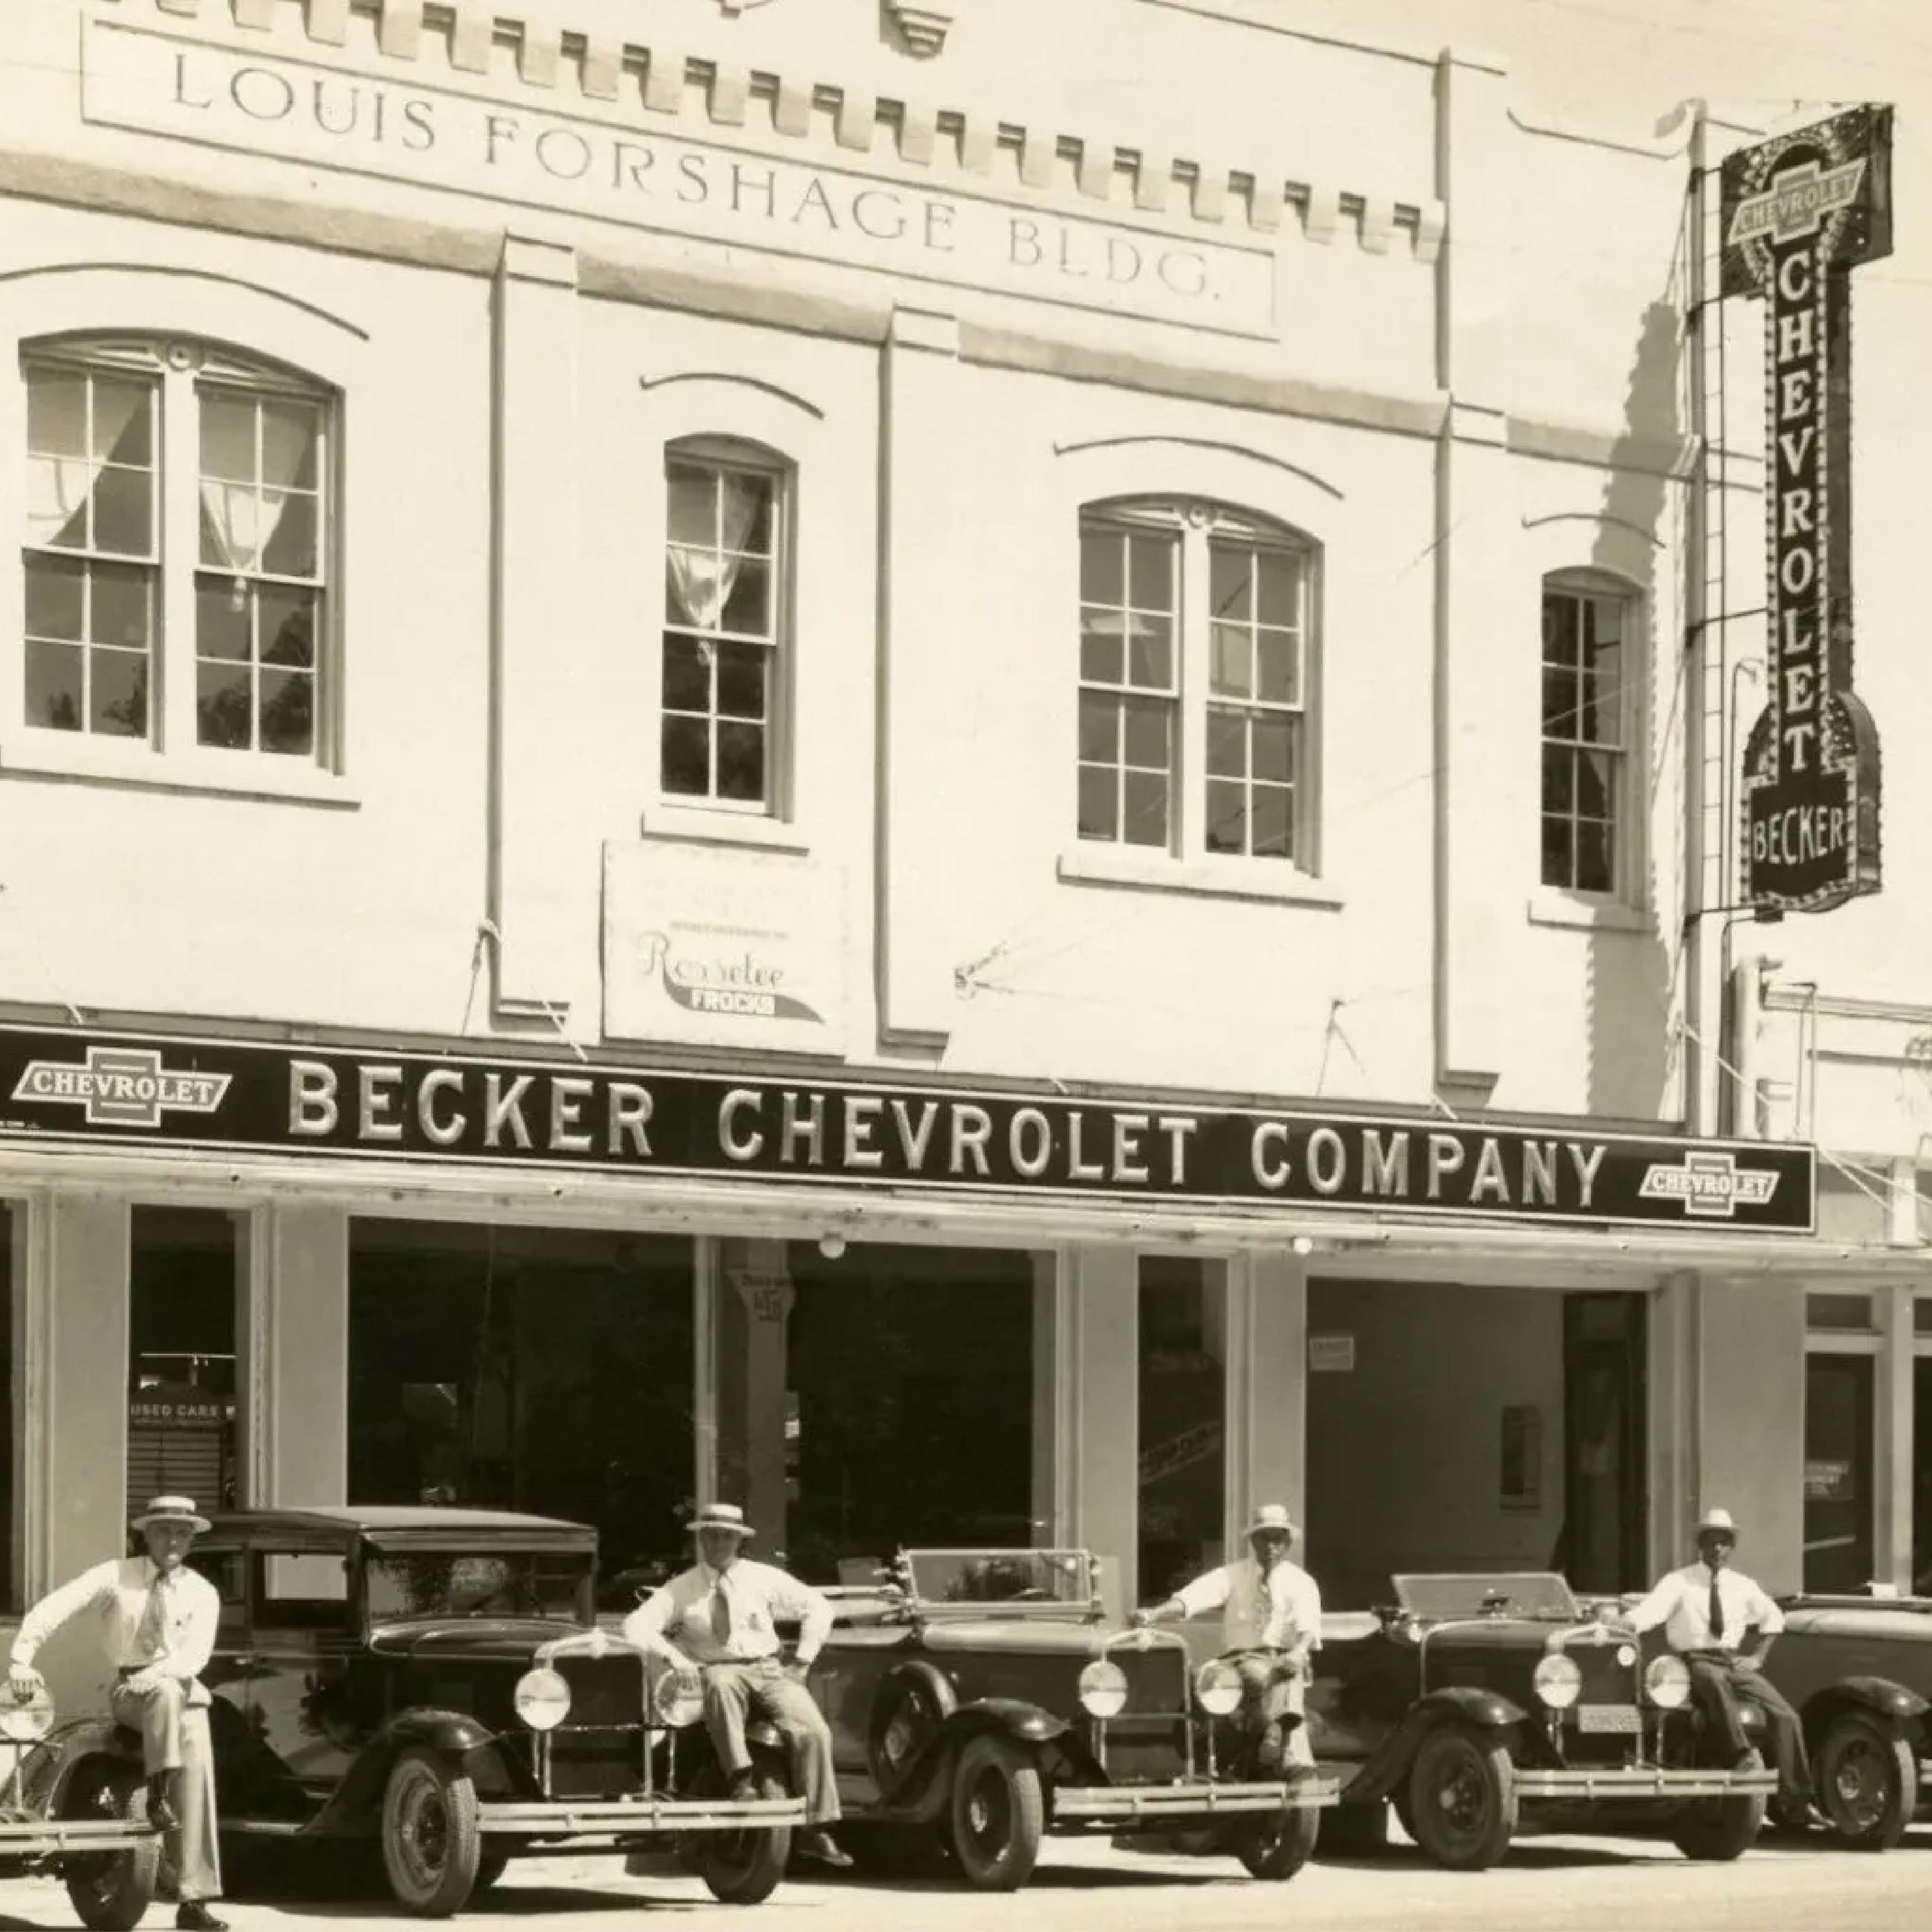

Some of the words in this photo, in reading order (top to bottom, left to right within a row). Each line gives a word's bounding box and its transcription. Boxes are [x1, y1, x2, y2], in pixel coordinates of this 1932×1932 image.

[175, 54, 435, 150] LOUIS
[483, 114, 956, 251] FORSHAGE
[1009, 218, 1220, 302] BLDG.
[1740, 173, 1855, 229] CHEVROLET
[1778, 250, 1815, 773] CHEVROLET
[1753, 804, 1844, 865] BECKER
[33, 1070, 214, 1103] CHEVROLET
[288, 1060, 654, 1156] BECKER
[718, 1089, 1198, 1185] CHEVROLET
[1251, 1122, 1607, 1208] COMPANY
[1652, 1172, 1771, 1198] CHEVROLET
